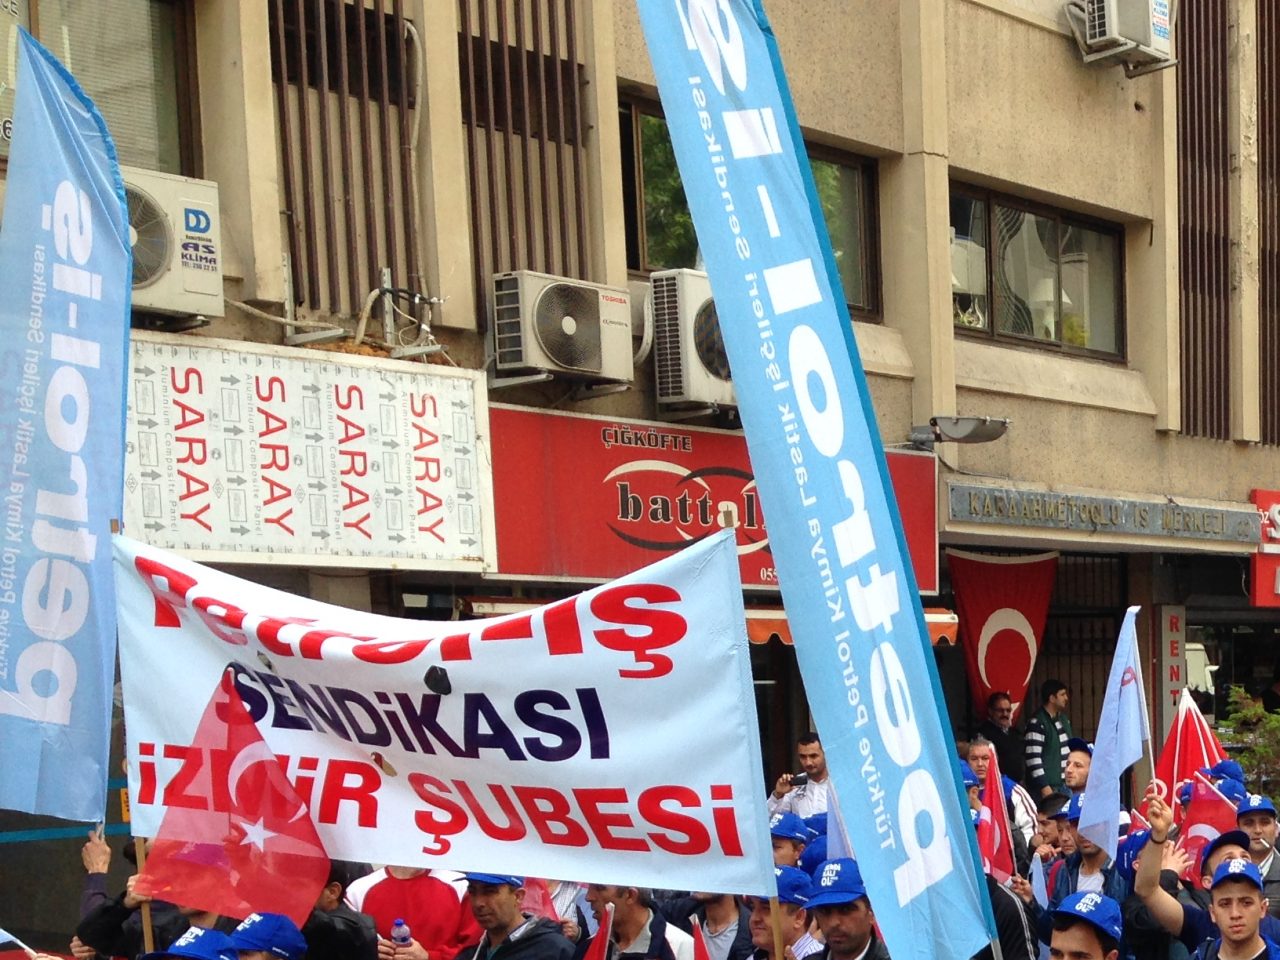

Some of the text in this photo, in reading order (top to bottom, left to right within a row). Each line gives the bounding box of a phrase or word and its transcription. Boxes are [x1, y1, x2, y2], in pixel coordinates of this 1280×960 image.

[181, 252, 217, 265] KLİMA
[601, 295, 627, 305] TOSHIBA
[160, 365, 178, 533] Aluminium Composite Panel
[170, 366, 213, 533] SARAY
[245, 373, 263, 537] Aluminium Composite Panel
[254, 375, 295, 536] SARAY
[325, 383, 343, 541] Aluminium Composite Panel
[334, 383, 373, 541] SARAY
[400, 391, 416, 544] Aluminium Composite Panel
[409, 392, 446, 544] SARAY
[601, 424, 693, 452] ÇİĞKÖFTE
[616, 481, 768, 529] battal
[215, 661, 610, 761] SENDİKASI
[1169, 615, 1180, 706] RENT
[407, 772, 744, 857] ŞUBESİ
